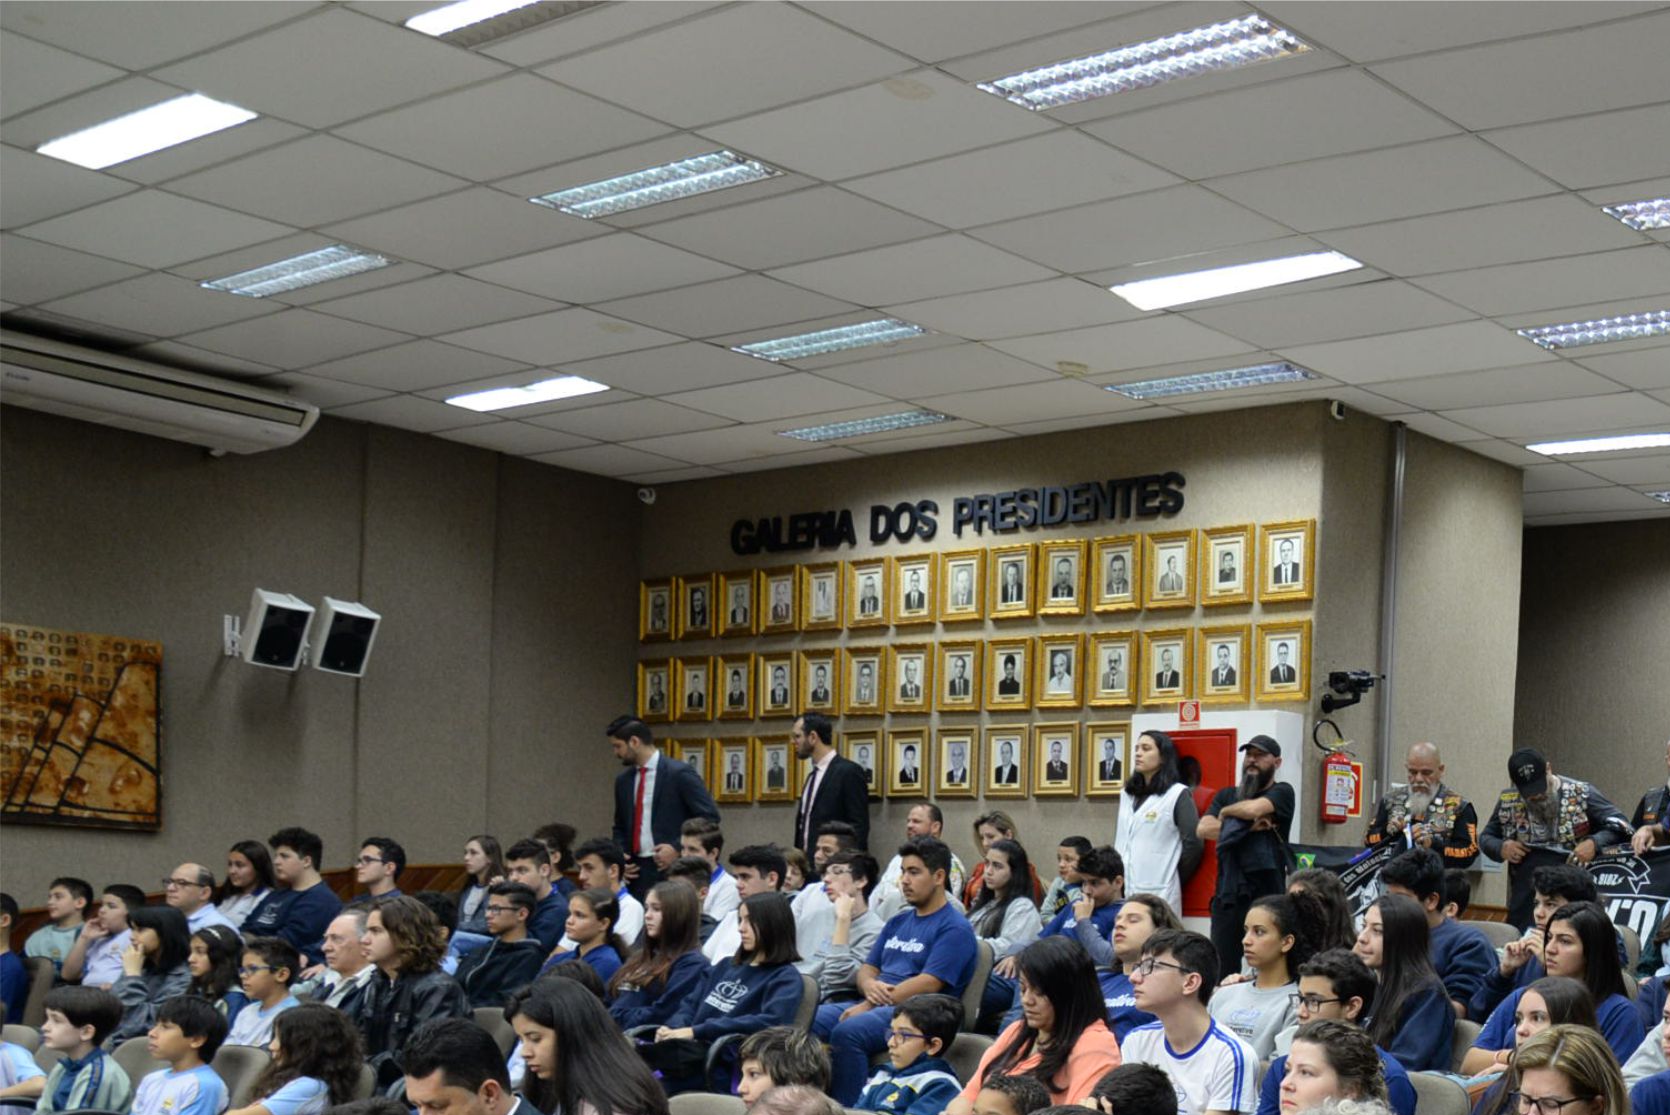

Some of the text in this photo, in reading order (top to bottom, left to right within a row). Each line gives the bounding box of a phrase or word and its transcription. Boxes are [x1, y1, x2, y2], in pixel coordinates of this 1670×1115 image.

[730, 471, 1187, 555] GALERIA DOS PRESIDENTES
